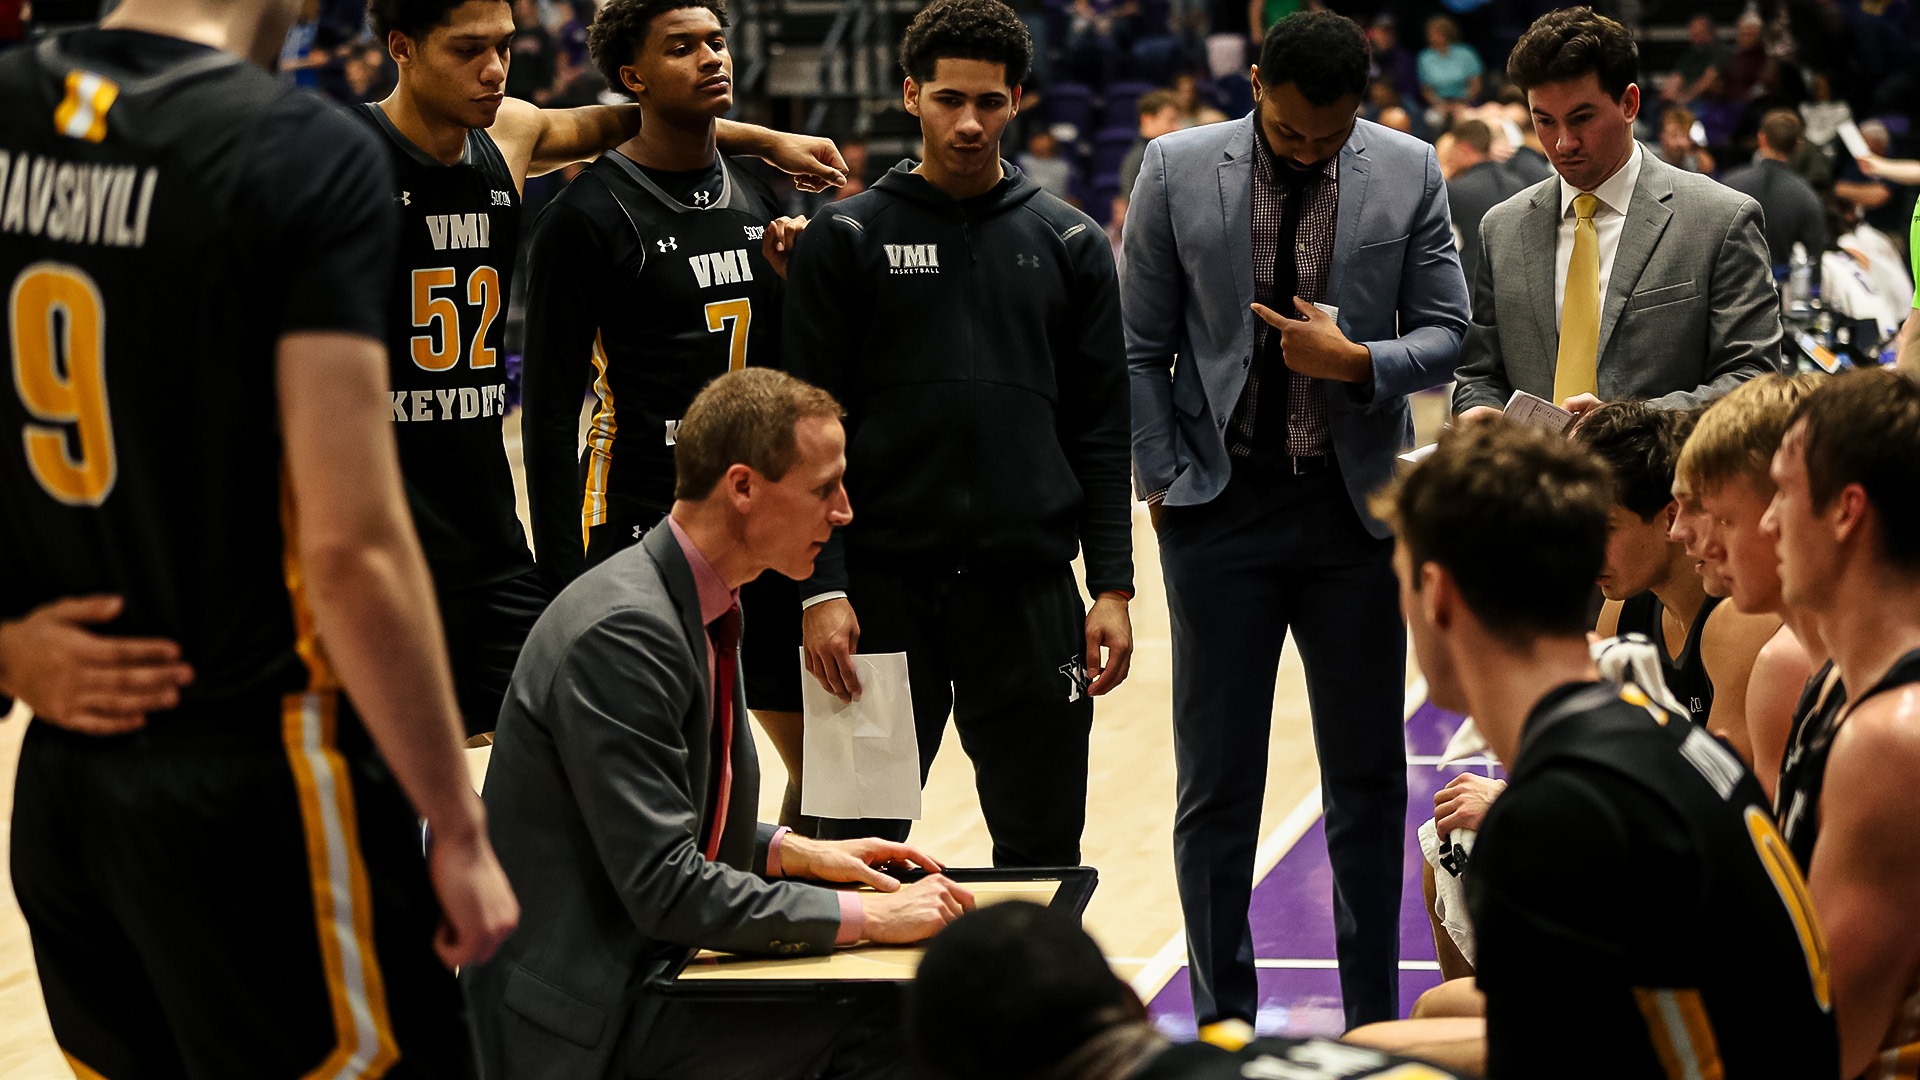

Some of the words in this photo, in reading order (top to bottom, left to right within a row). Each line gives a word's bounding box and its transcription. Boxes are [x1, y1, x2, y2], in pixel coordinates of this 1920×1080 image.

[425, 213, 490, 250] VMI
[688, 249, 754, 288] VMI
[883, 244, 939, 268] VMI
[889, 267, 940, 275] BASKETBALL
[411, 265, 501, 372] 52
[704, 297, 752, 373] 7
[7, 260, 117, 507] 9
[387, 383, 506, 422] KEYDETS
